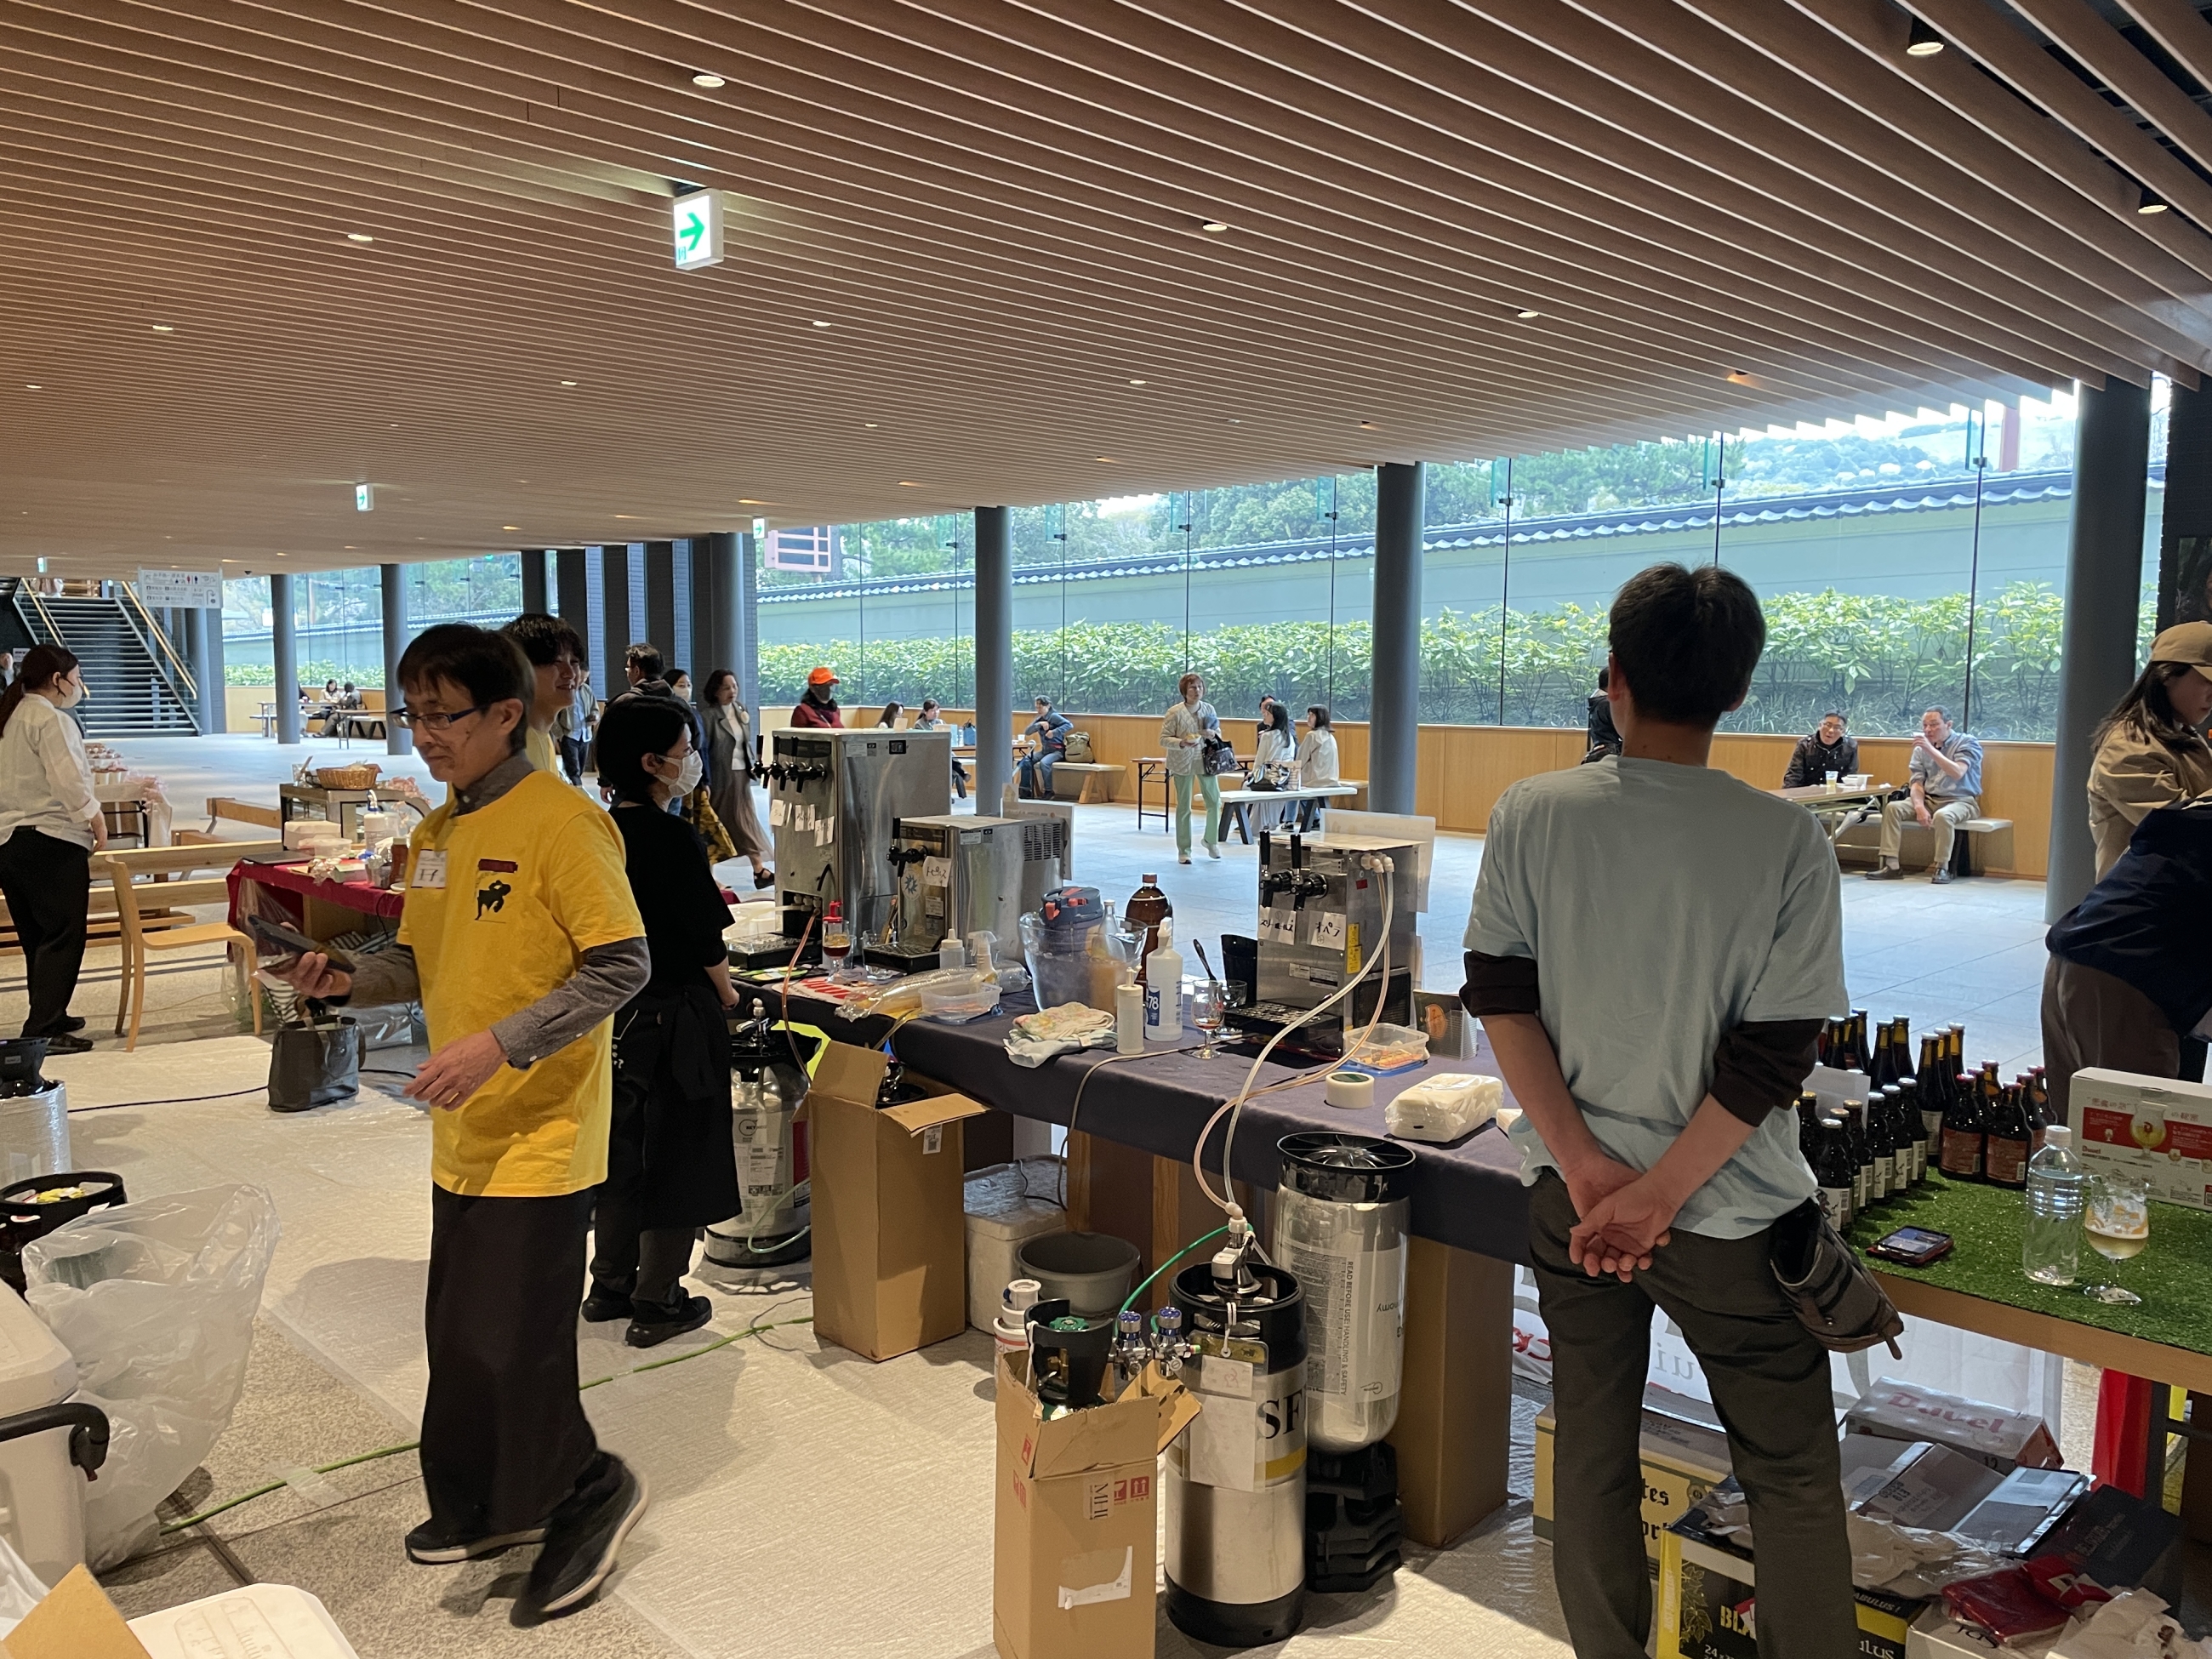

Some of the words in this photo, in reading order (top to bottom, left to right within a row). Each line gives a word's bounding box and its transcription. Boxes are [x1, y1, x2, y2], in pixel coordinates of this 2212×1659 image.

[1344, 1281, 1353, 1308] BEFORE
[1342, 1325, 1350, 1362] HANDLING
[1340, 1370, 1348, 1395] SAFETY
[1888, 1391, 2004, 1434] Duvel
[1705, 1644, 1718, 1657] 24
